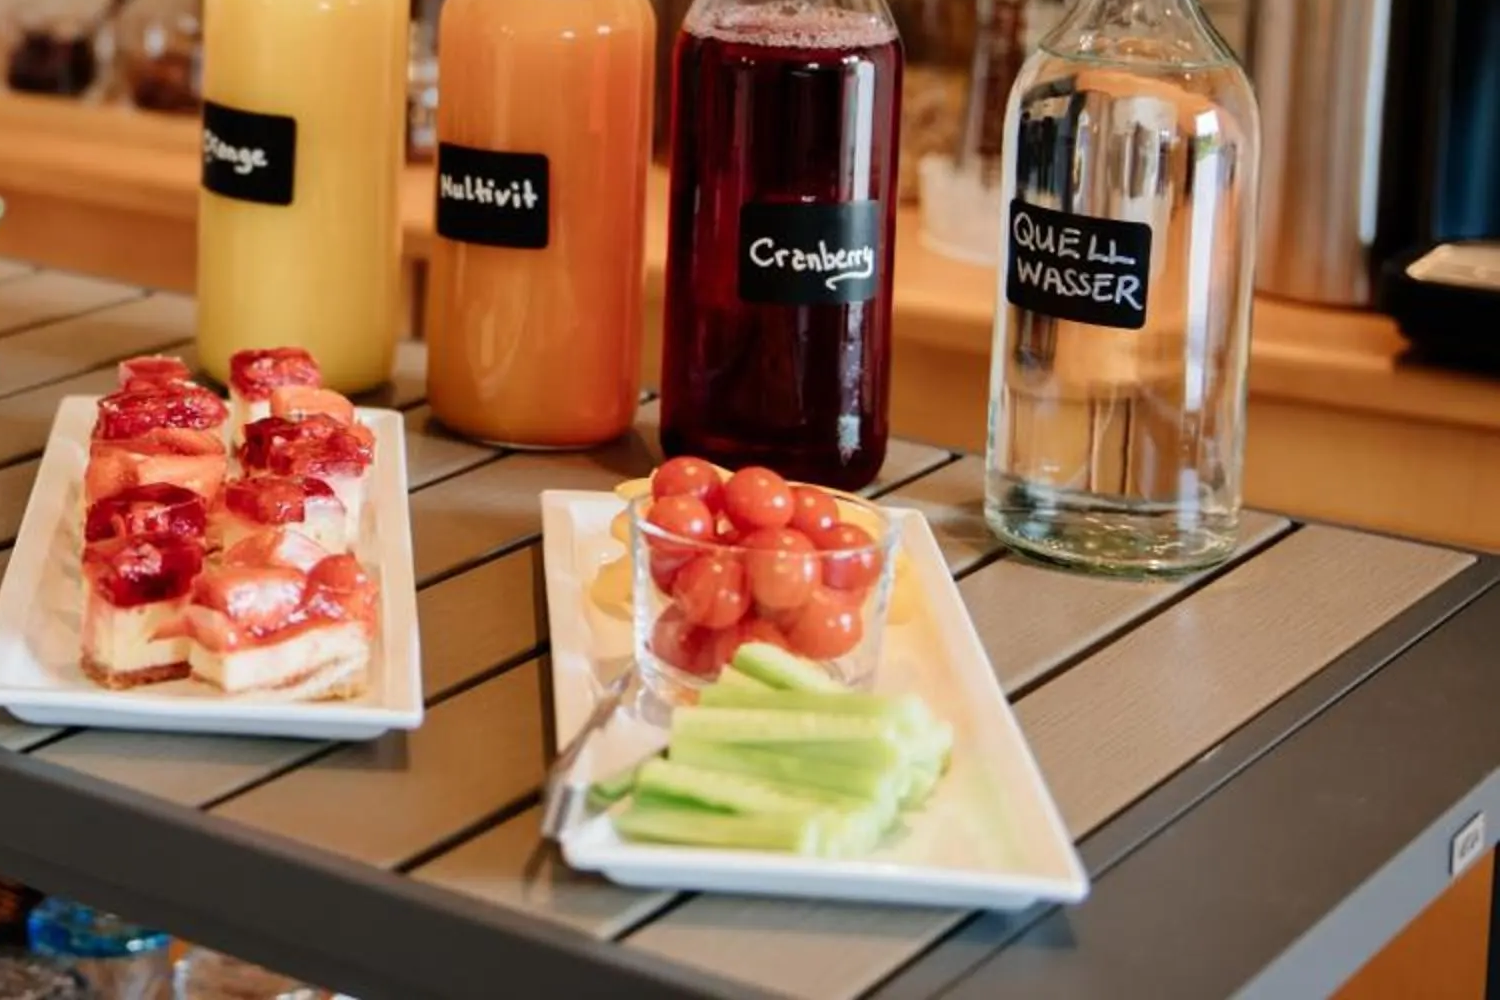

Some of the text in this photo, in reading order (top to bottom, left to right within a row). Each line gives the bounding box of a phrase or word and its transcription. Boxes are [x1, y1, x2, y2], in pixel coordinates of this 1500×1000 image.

[749, 237, 874, 291] Cranberry
[1012, 212, 1135, 265] QUELL
[1017, 257, 1143, 310] WASSER
